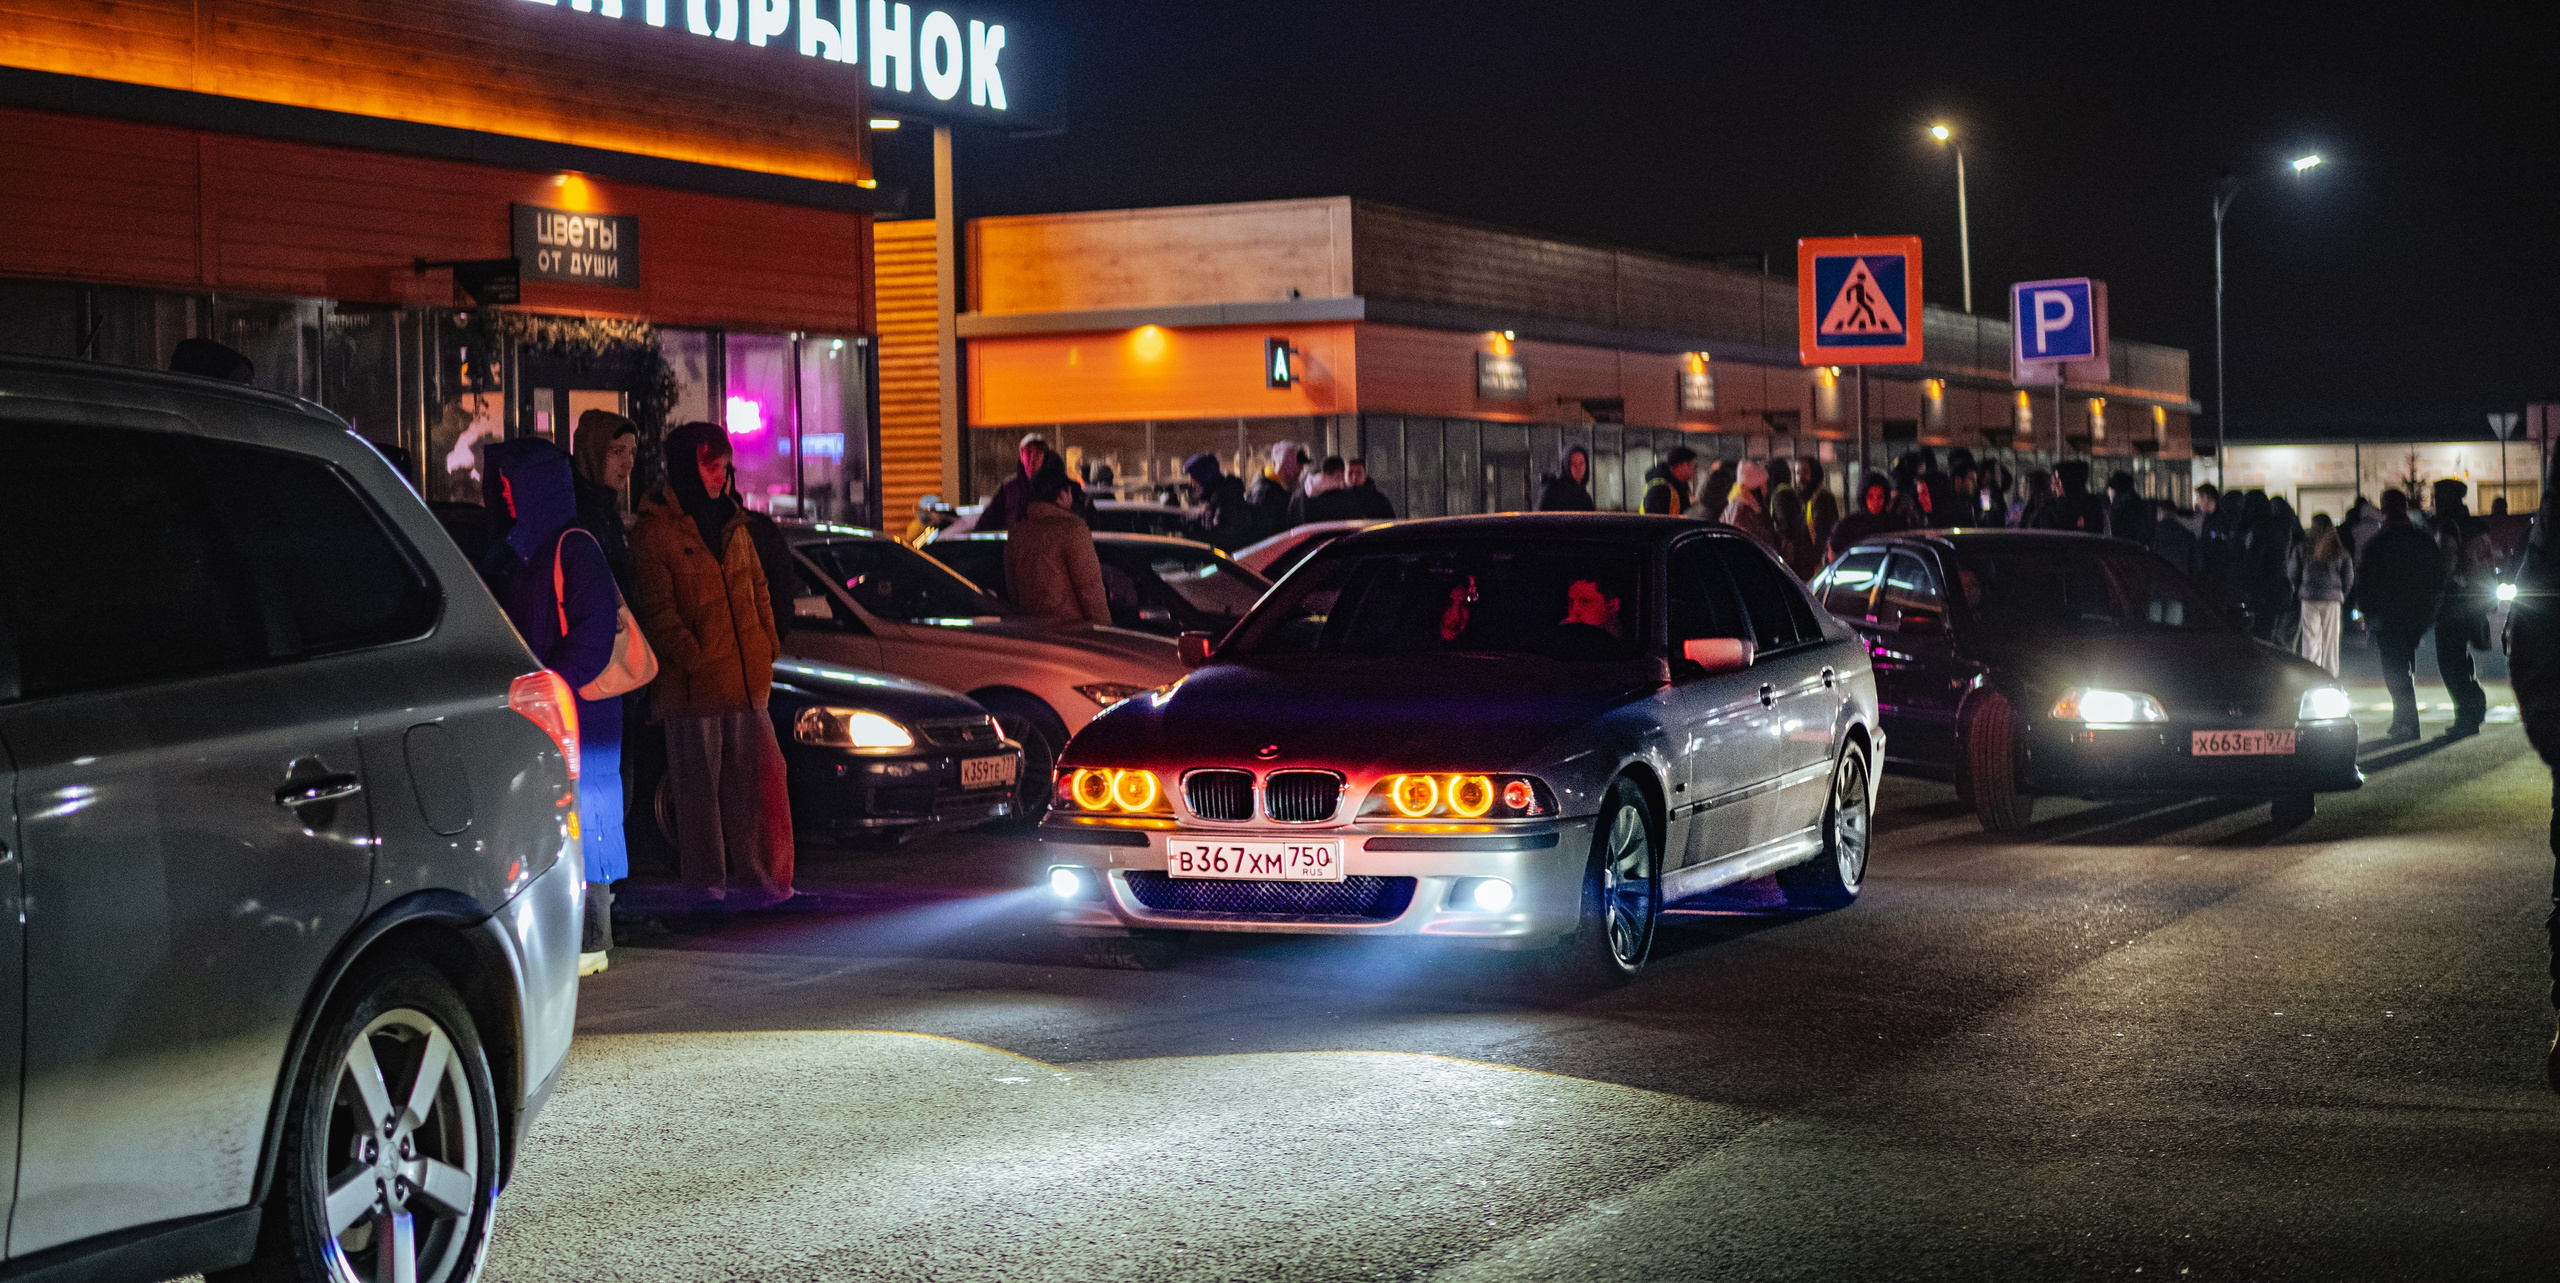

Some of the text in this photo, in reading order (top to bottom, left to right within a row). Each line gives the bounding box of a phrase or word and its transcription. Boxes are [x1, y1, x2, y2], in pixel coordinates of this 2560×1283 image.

[538, 249, 618, 279] ОТ ДУШИ
[2034, 290, 2074, 354] P
[2266, 731, 2291, 747] 977
[1180, 846, 1329, 874] В367ХМ 750
[1302, 868, 1323, 876] RUS
